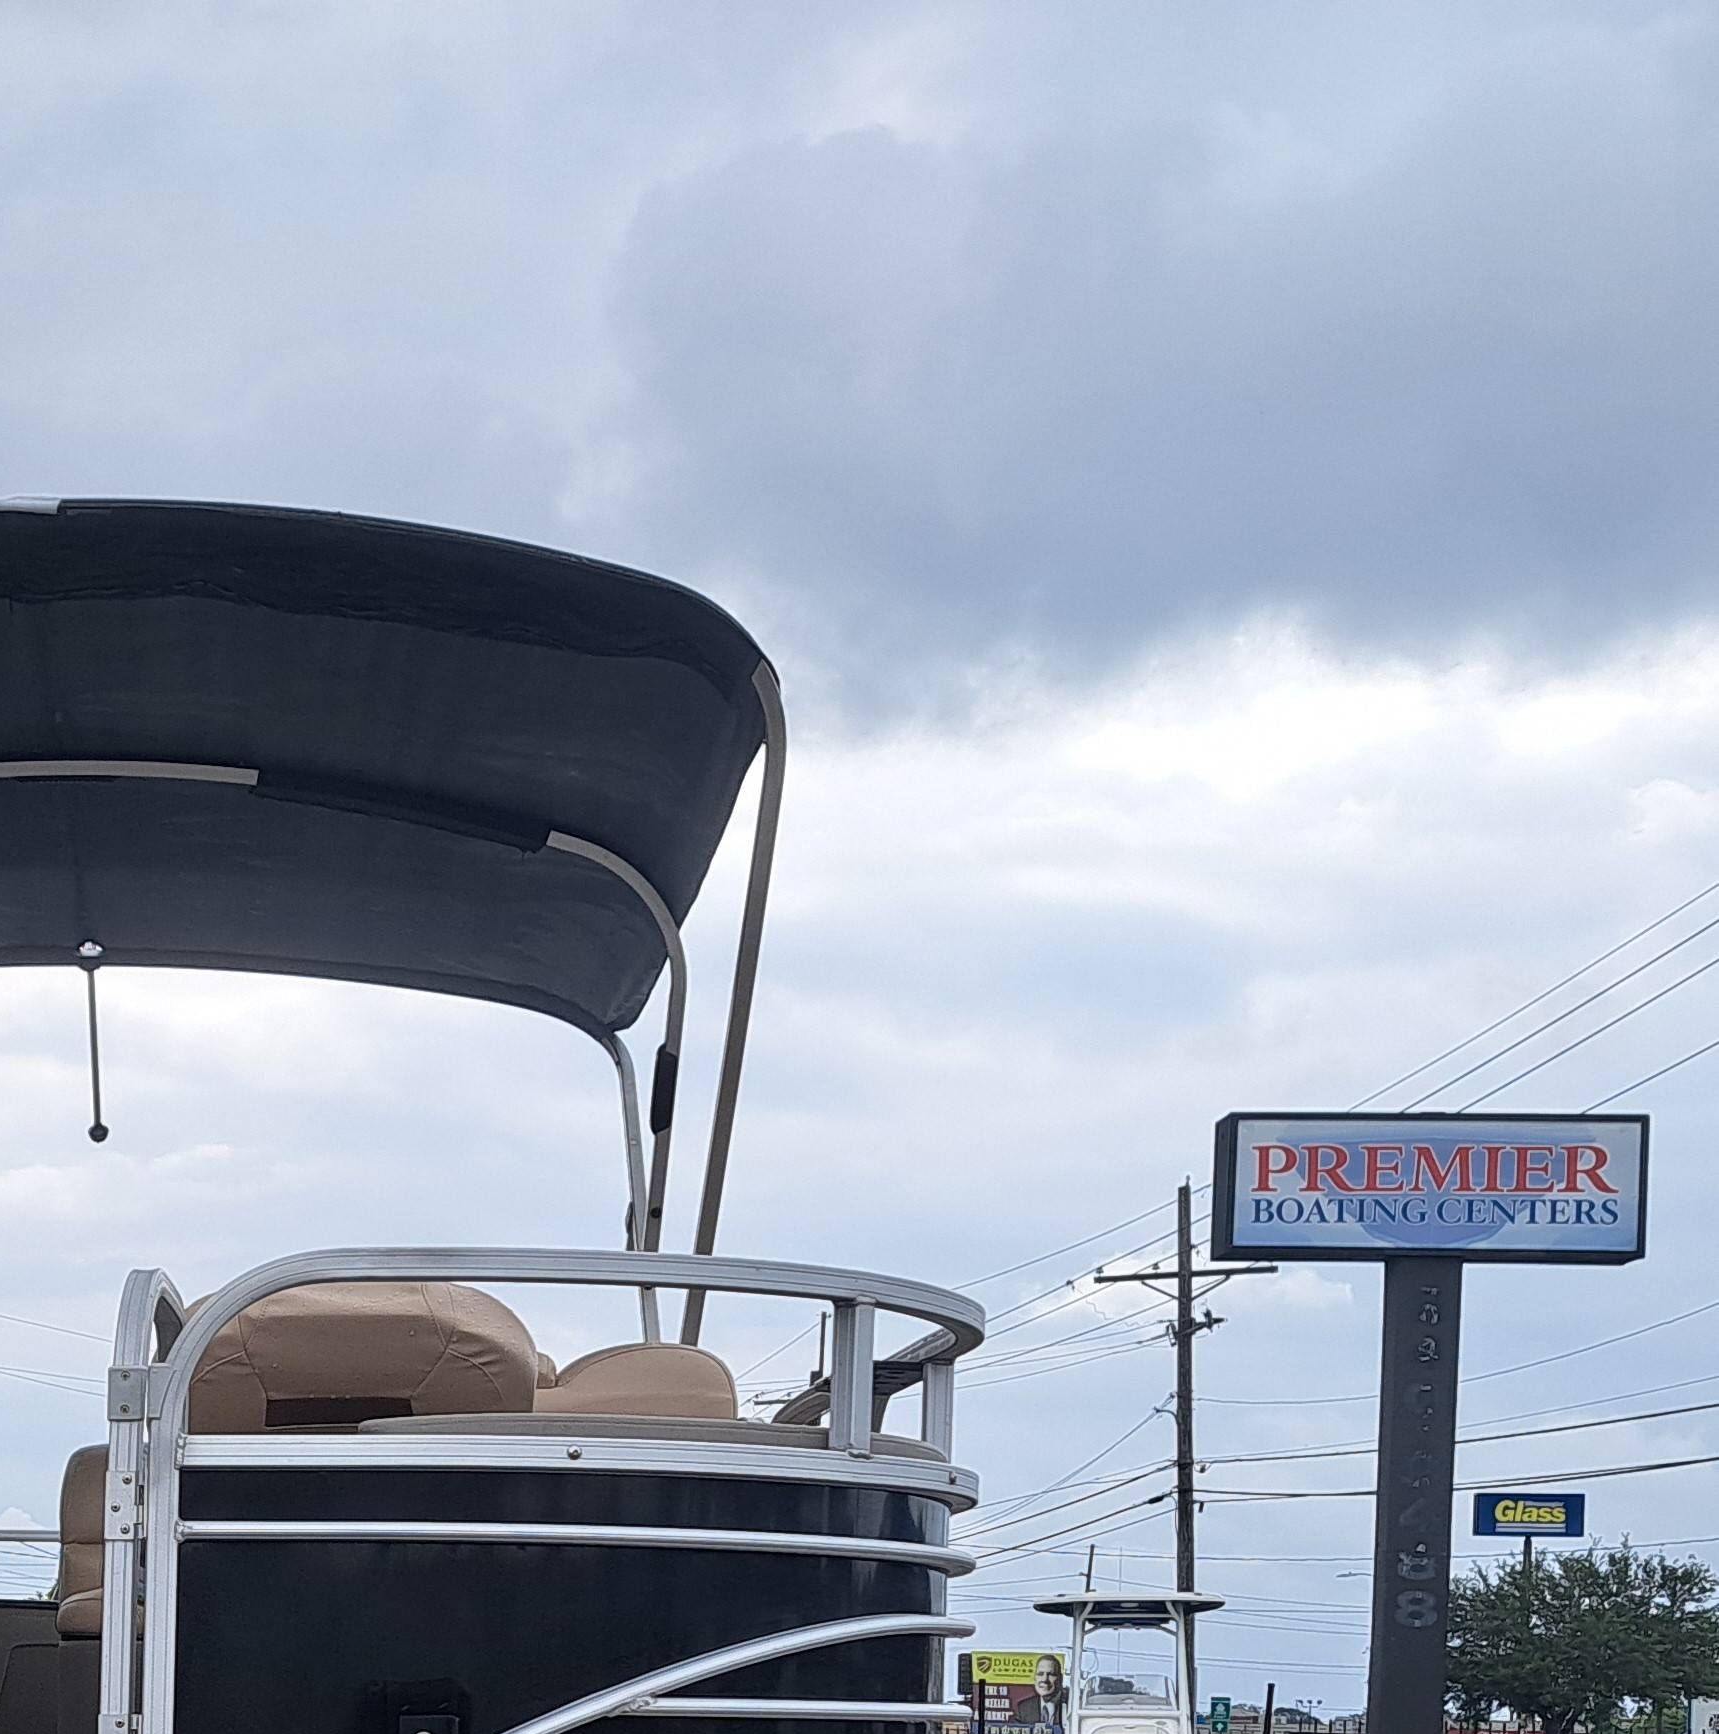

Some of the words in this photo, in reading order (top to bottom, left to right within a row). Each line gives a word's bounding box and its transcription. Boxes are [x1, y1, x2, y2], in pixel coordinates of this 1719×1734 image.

[1250, 1144, 1619, 1194] PREMIER
[1250, 1197, 1427, 1226] BOATING
[1437, 1197, 1620, 1226] CENTERS
[1494, 1499, 1566, 1523] Glass
[993, 1657, 1034, 1668] DUGAS
